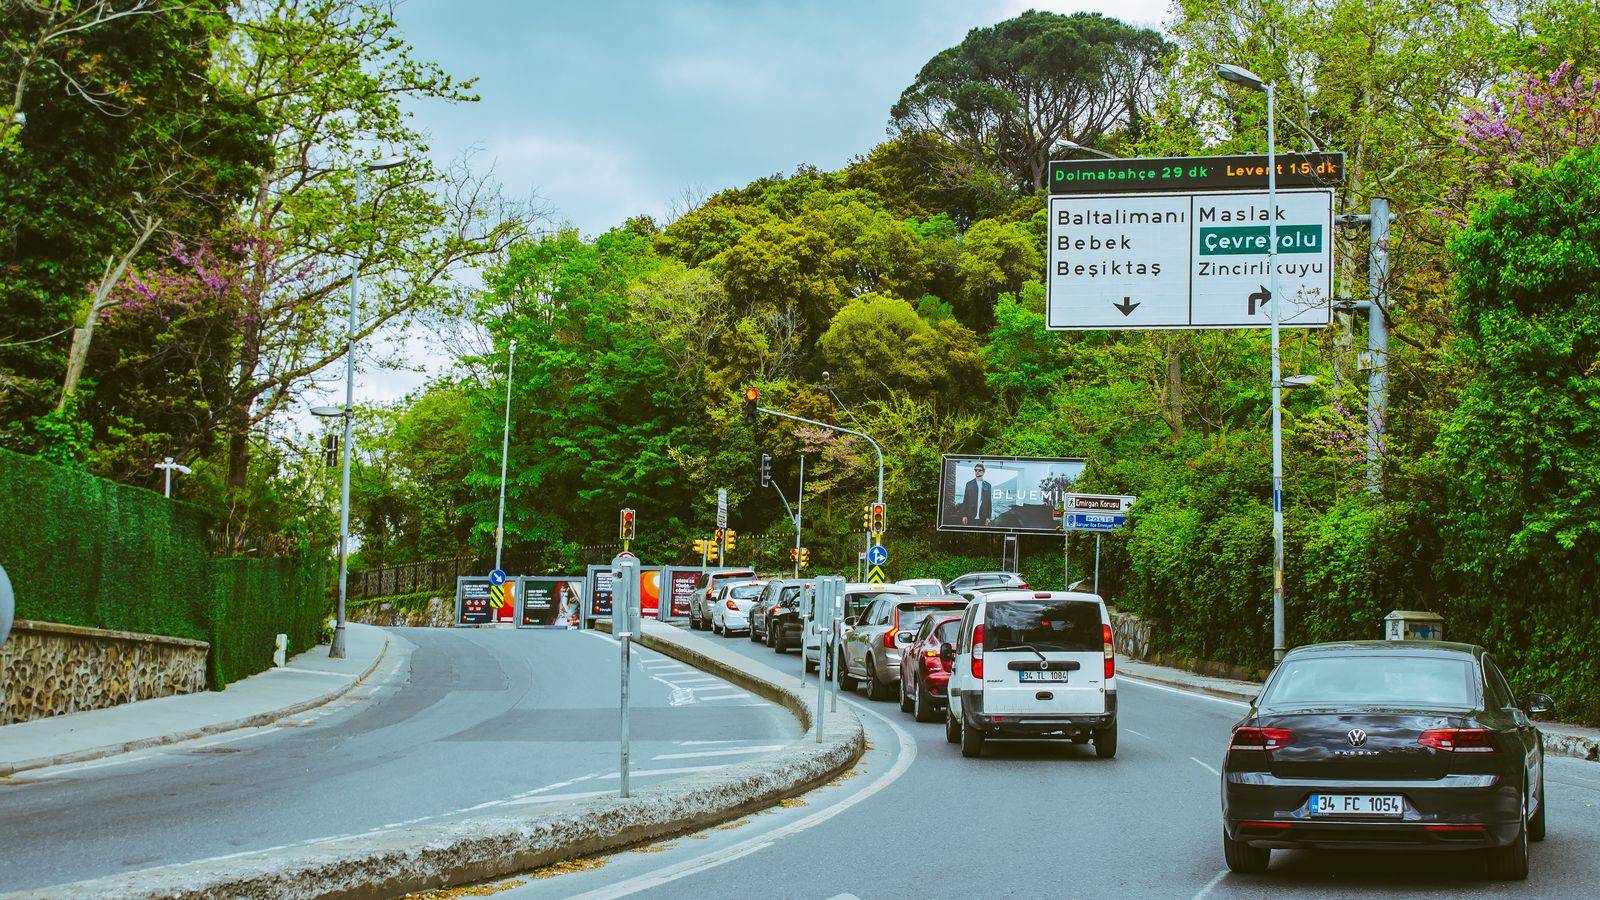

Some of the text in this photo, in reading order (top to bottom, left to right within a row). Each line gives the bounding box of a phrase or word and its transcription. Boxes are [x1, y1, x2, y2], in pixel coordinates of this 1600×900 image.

[1055, 167, 1208, 183] Dolmabahçe 29 dk
[1290, 163, 1310, 174] 15
[1317, 163, 1336, 174] dk
[1058, 209, 1185, 225] Baltalimanı
[1200, 205, 1286, 222] Maslak
[1058, 235, 1131, 250] Bebek
[1057, 260, 1161, 278] Beşiktaş
[1025, 671, 1067, 680] 34 TL 1084
[1320, 797, 1335, 811] 34
[1344, 797, 1360, 811] FC
[1369, 797, 1399, 812] 1054
